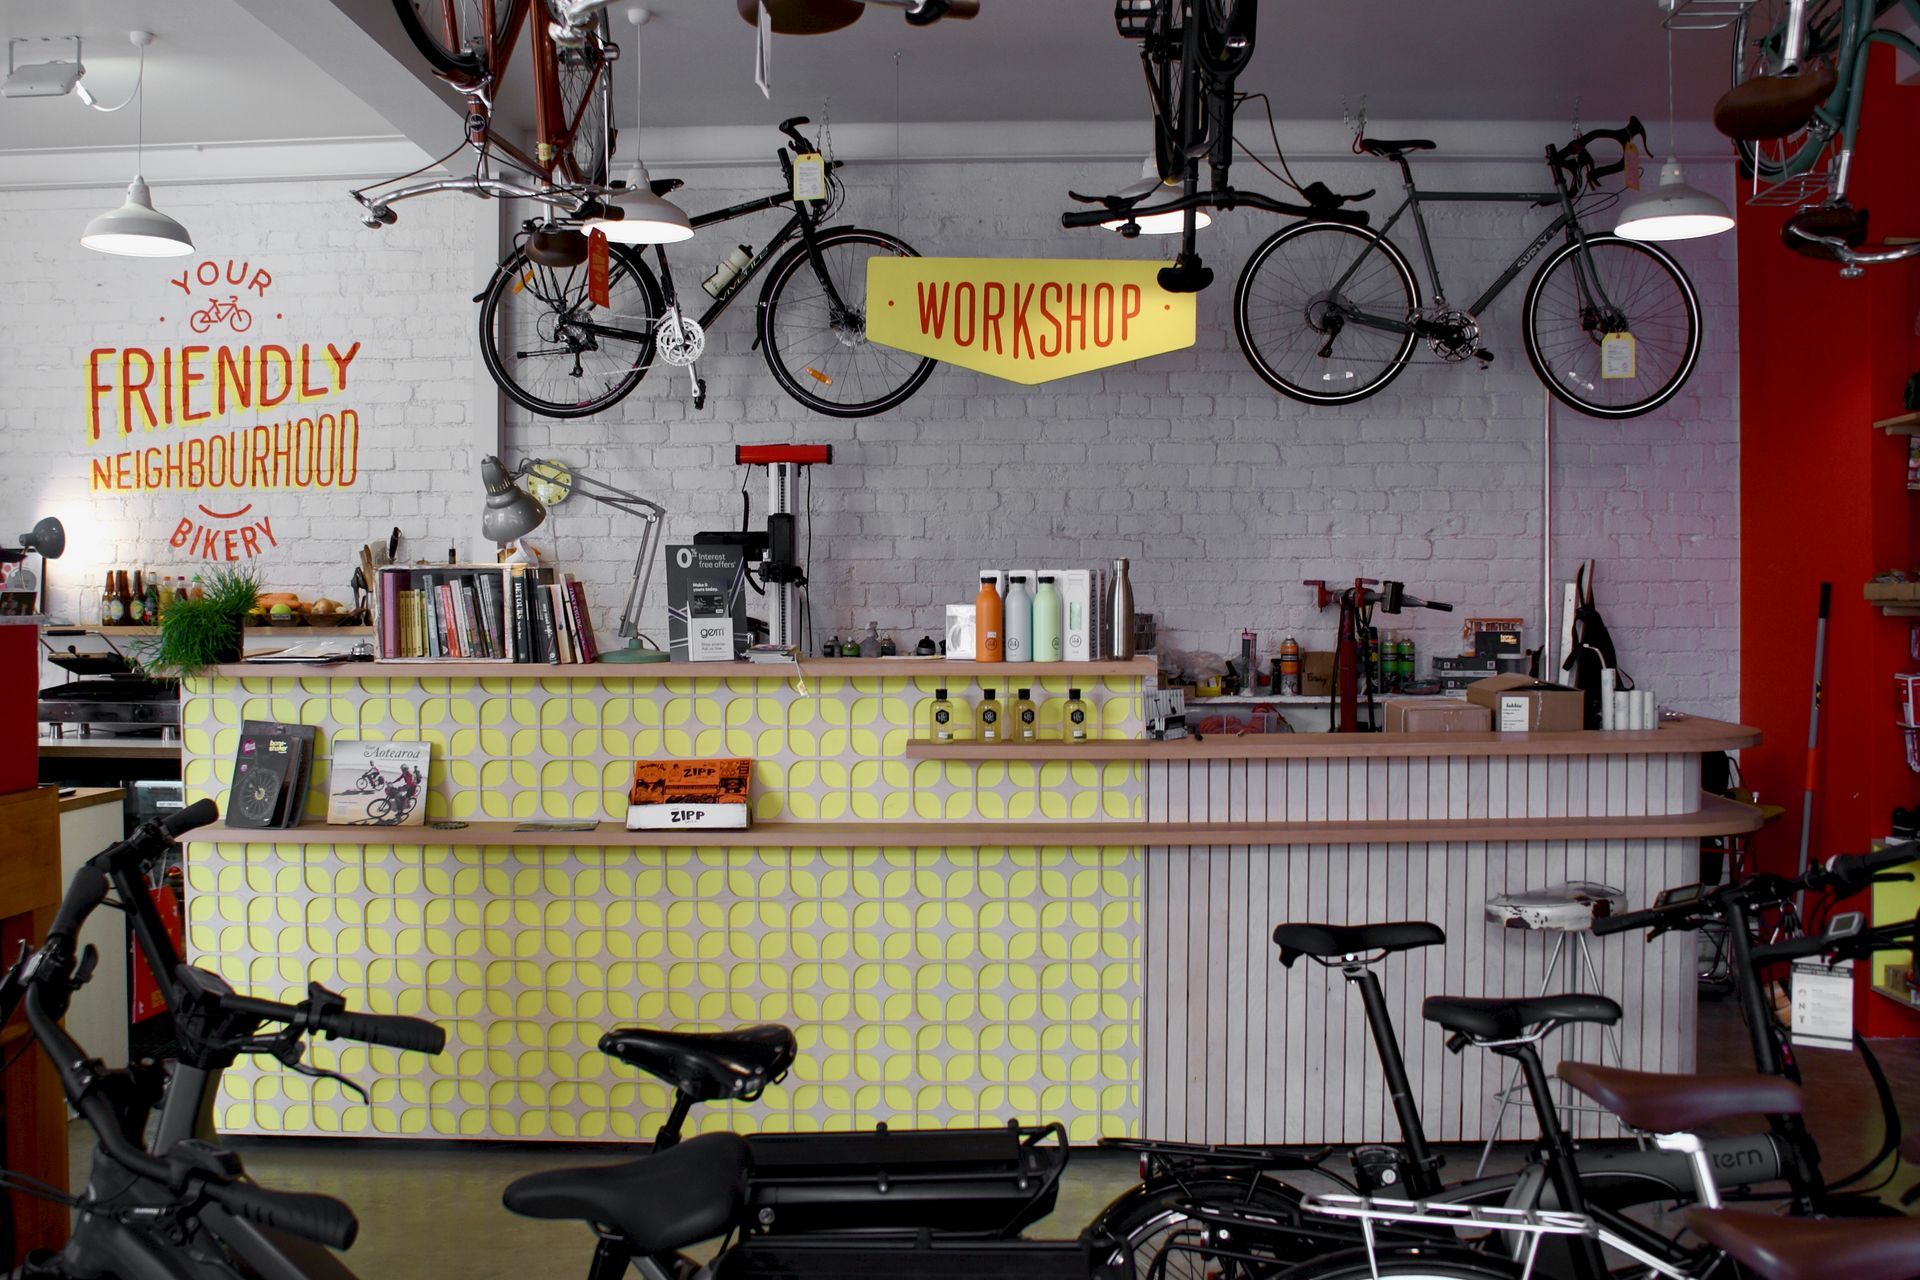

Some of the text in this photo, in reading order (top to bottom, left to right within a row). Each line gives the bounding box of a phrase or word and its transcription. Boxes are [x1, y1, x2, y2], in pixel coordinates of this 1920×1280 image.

[1517, 236, 1549, 269] SURLY
[171, 260, 272, 297] YOUR
[917, 281, 1141, 360] WORKSHOP
[88, 342, 361, 440] FRIENDLY
[92, 409, 359, 490] NEIGHBOURHOOD
[169, 516, 278, 561] BIKERY
[698, 553, 726, 561] Interest
[698, 560, 713, 569] free
[515, 583, 523, 619] DETOURS
[572, 606, 583, 630] CYCLING
[363, 746, 421, 759] Aotearoa
[683, 767, 716, 778] ZIPP
[670, 810, 705, 823] ZIPP
[1712, 1147, 1764, 1169] tern
